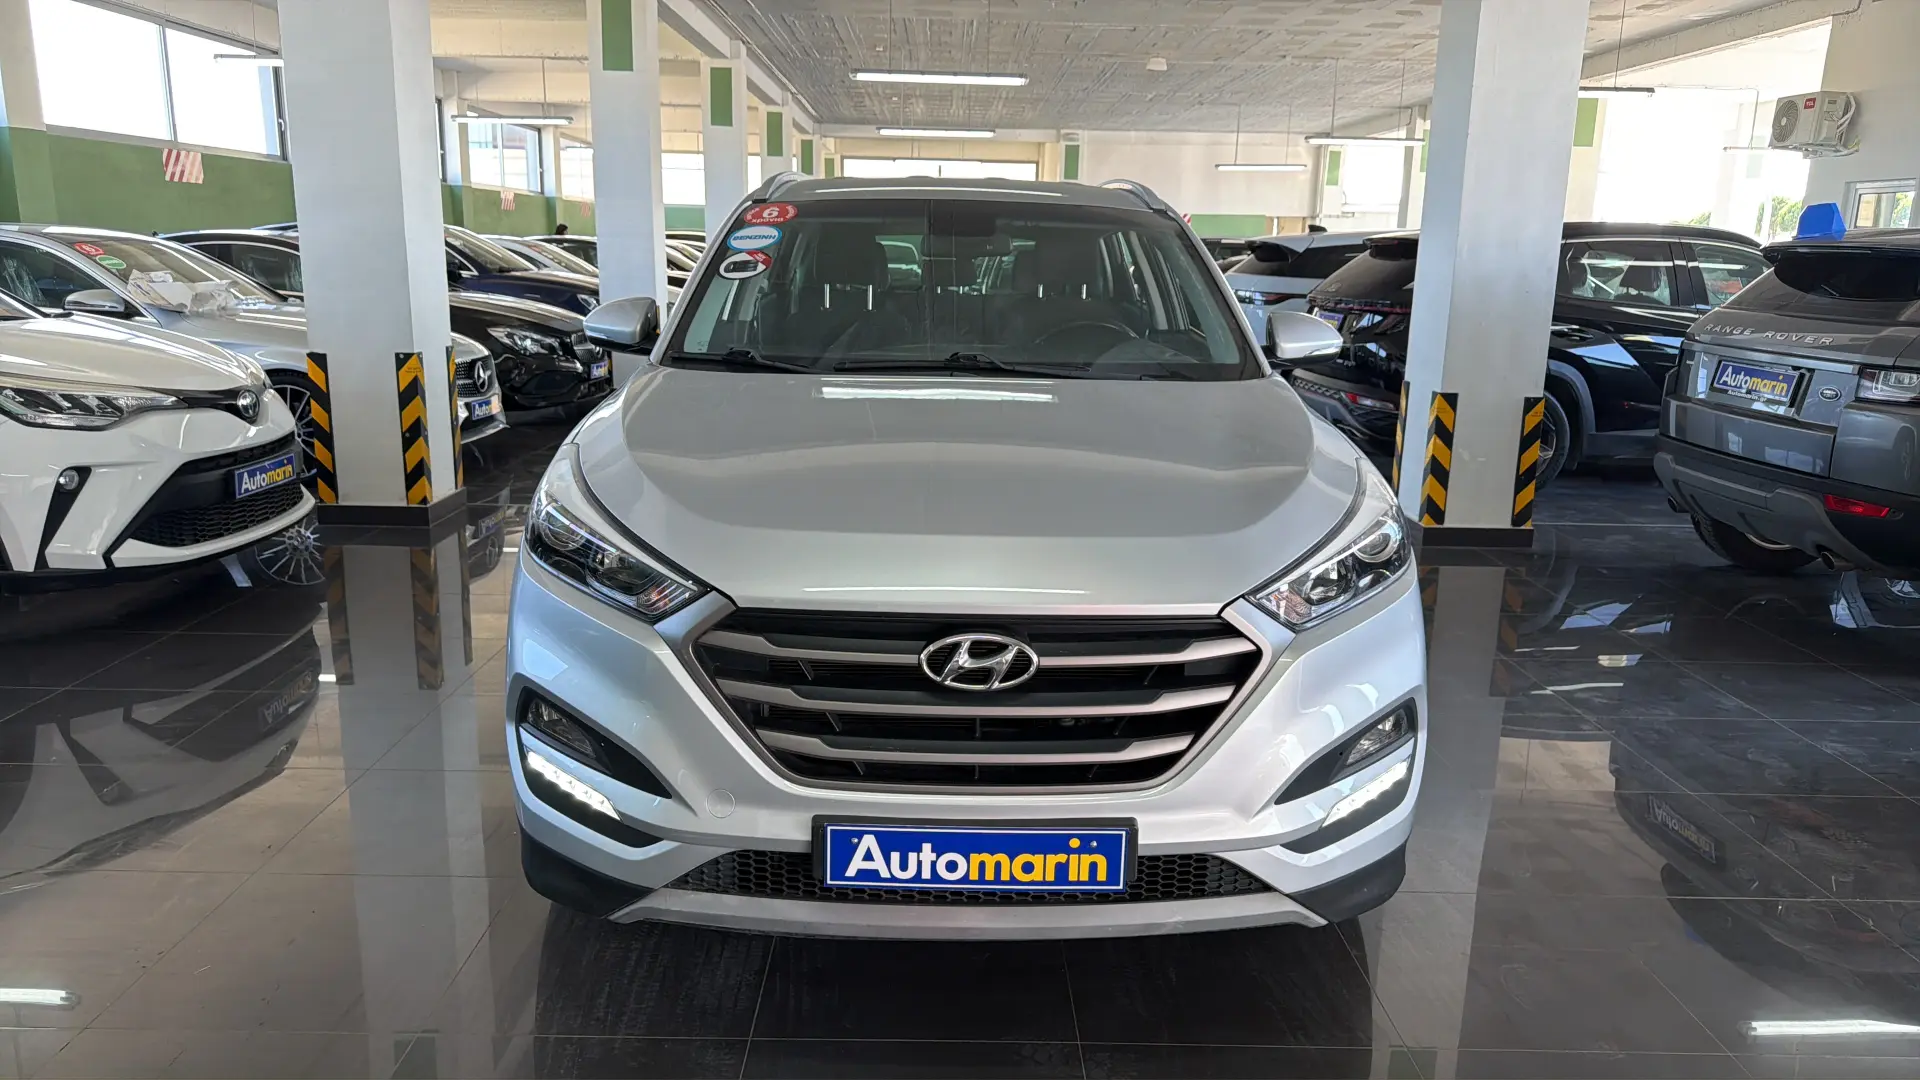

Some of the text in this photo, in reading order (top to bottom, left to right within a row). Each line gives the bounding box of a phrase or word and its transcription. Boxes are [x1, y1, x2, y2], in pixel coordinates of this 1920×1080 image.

[763, 206, 779, 218] 6
[1704, 323, 1834, 345] RANGE ROVER
[1720, 365, 1788, 396] Automarin
[241, 458, 293, 494] Automarin
[844, 834, 1107, 882] Automarin
